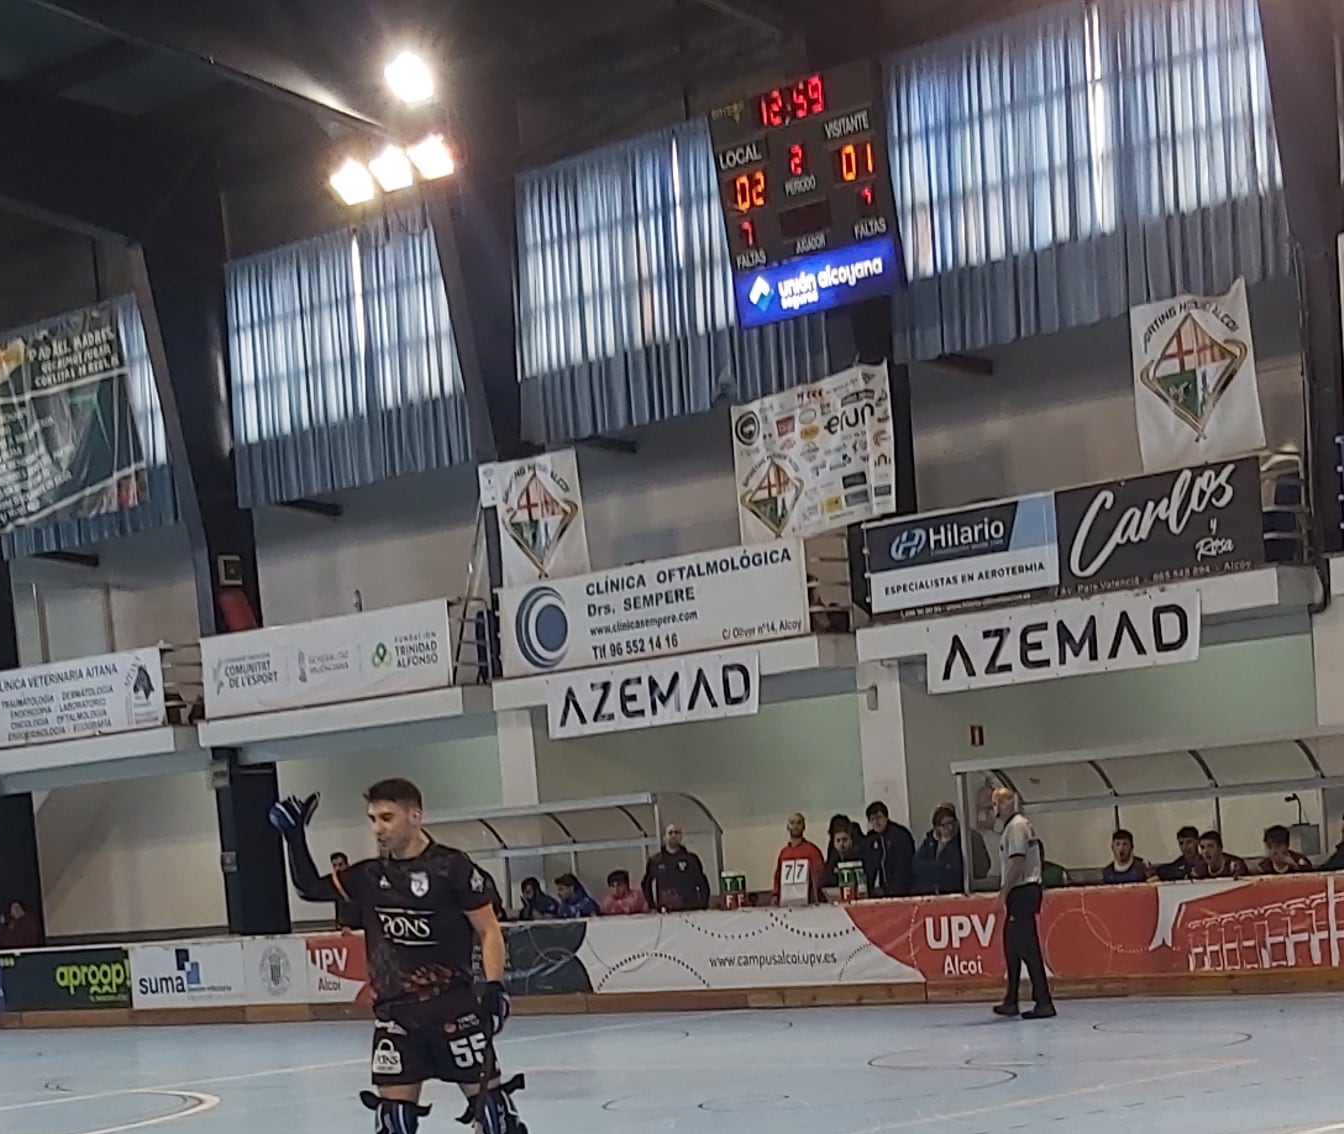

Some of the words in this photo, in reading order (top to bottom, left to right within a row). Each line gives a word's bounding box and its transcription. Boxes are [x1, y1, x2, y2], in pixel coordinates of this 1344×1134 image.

[824, 110, 869, 139] VISITANTE
[719, 143, 762, 170] LOCAL
[790, 144, 803, 175] 2
[841, 143, 874, 181] 01
[736, 170, 766, 213] 02
[854, 217, 887, 239] FALTAS
[736, 250, 766, 269] FALTAS
[818, 257, 883, 288] alcoyana
[929, 516, 1005, 550] Hilario
[1069, 463, 1235, 579] Carlos
[1209, 517, 1218, 536] y
[1195, 537, 1235, 562] Rosa
[586, 574, 647, 597] CLÍNICA
[656, 547, 792, 584] OFTALMOLÓGICA
[884, 576, 958, 597] ESPECIALISTAS
[961, 572, 975, 584] EN
[977, 561, 1046, 582] AEROTERMIA
[587, 603, 615, 618] Drs.
[623, 586, 696, 612] SEMPERE
[779, 619, 803, 633] Alcoy
[395, 641, 438, 658] TRINIDAD
[609, 641, 623, 658] 96
[625, 637, 646, 656] 552
[649, 635, 662, 651] 14
[665, 633, 679, 649] 16
[941, 604, 1190, 682] AZEMAD
[224, 660, 271, 678] COMUNITAT
[396, 654, 438, 669] ALFONSO
[559, 663, 752, 728] AZEMAD
[924, 912, 997, 949] UPV
[307, 948, 348, 973] UPV
[707, 949, 839, 971] www.campusalcoi.upv.es
[943, 954, 984, 976] Alcoi
[56, 959, 132, 996] aproop!
[138, 973, 186, 996] suma
[318, 977, 342, 992] Alcoi
[448, 1032, 488, 1069] 55
